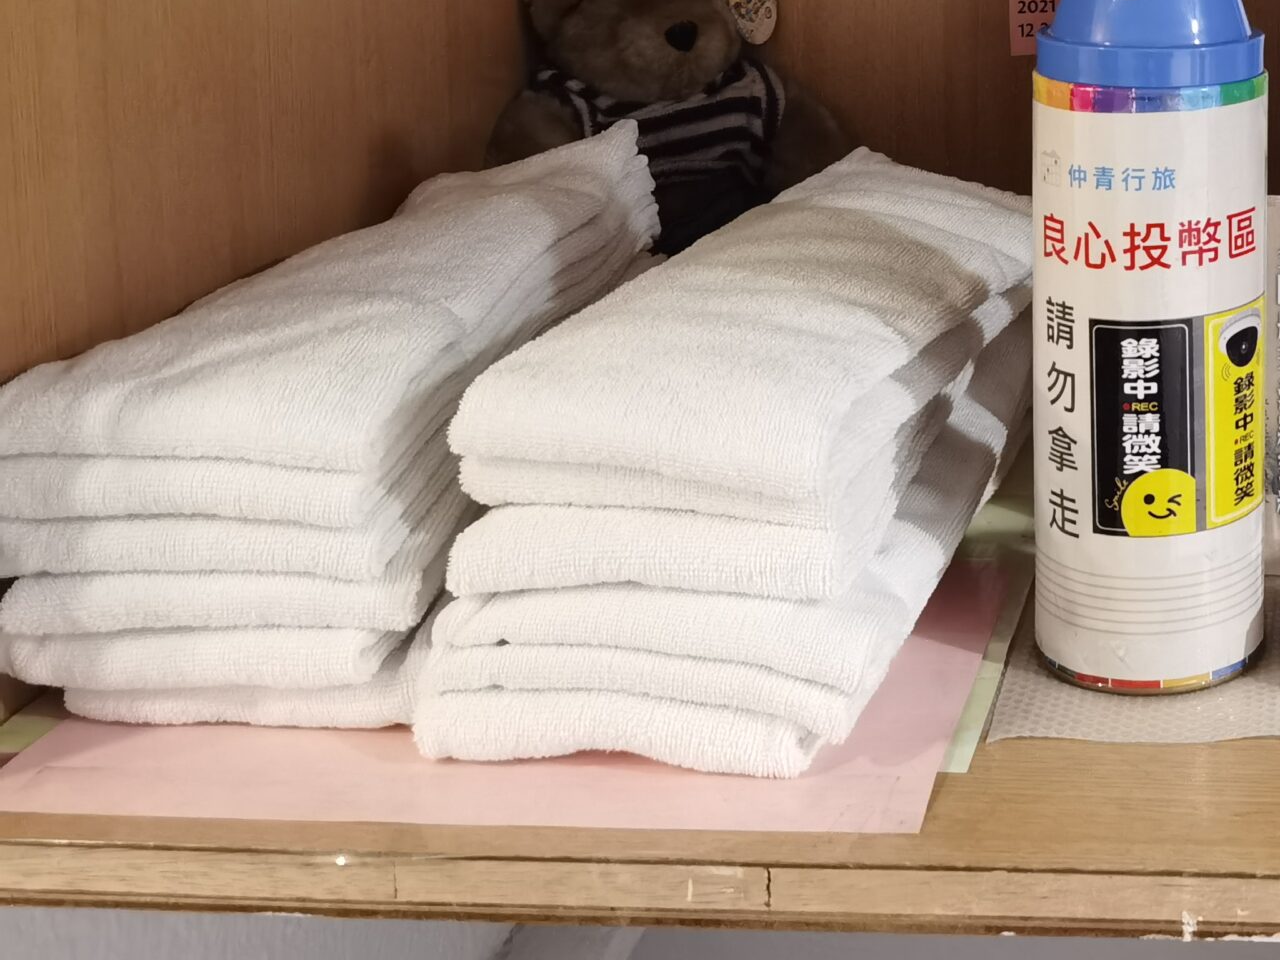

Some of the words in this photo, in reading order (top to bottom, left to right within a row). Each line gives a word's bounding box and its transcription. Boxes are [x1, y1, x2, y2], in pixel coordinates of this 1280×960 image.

[1017, 0, 1056, 14] 2021
[1068, 164, 1177, 192] 仲青行旅
[1042, 206, 1257, 272] 良心投幣區
[1119, 337, 1161, 400] 錄影中
[1045, 295, 1080, 539] 請勿拿走
[1132, 402, 1159, 412] REC
[1232, 370, 1255, 432] 錄影中
[1122, 412, 1162, 475] 請微笑
[1239, 433, 1255, 444] REC
[1104, 479, 1130, 512] Smile
[1232, 442, 1256, 507] 請微笑
